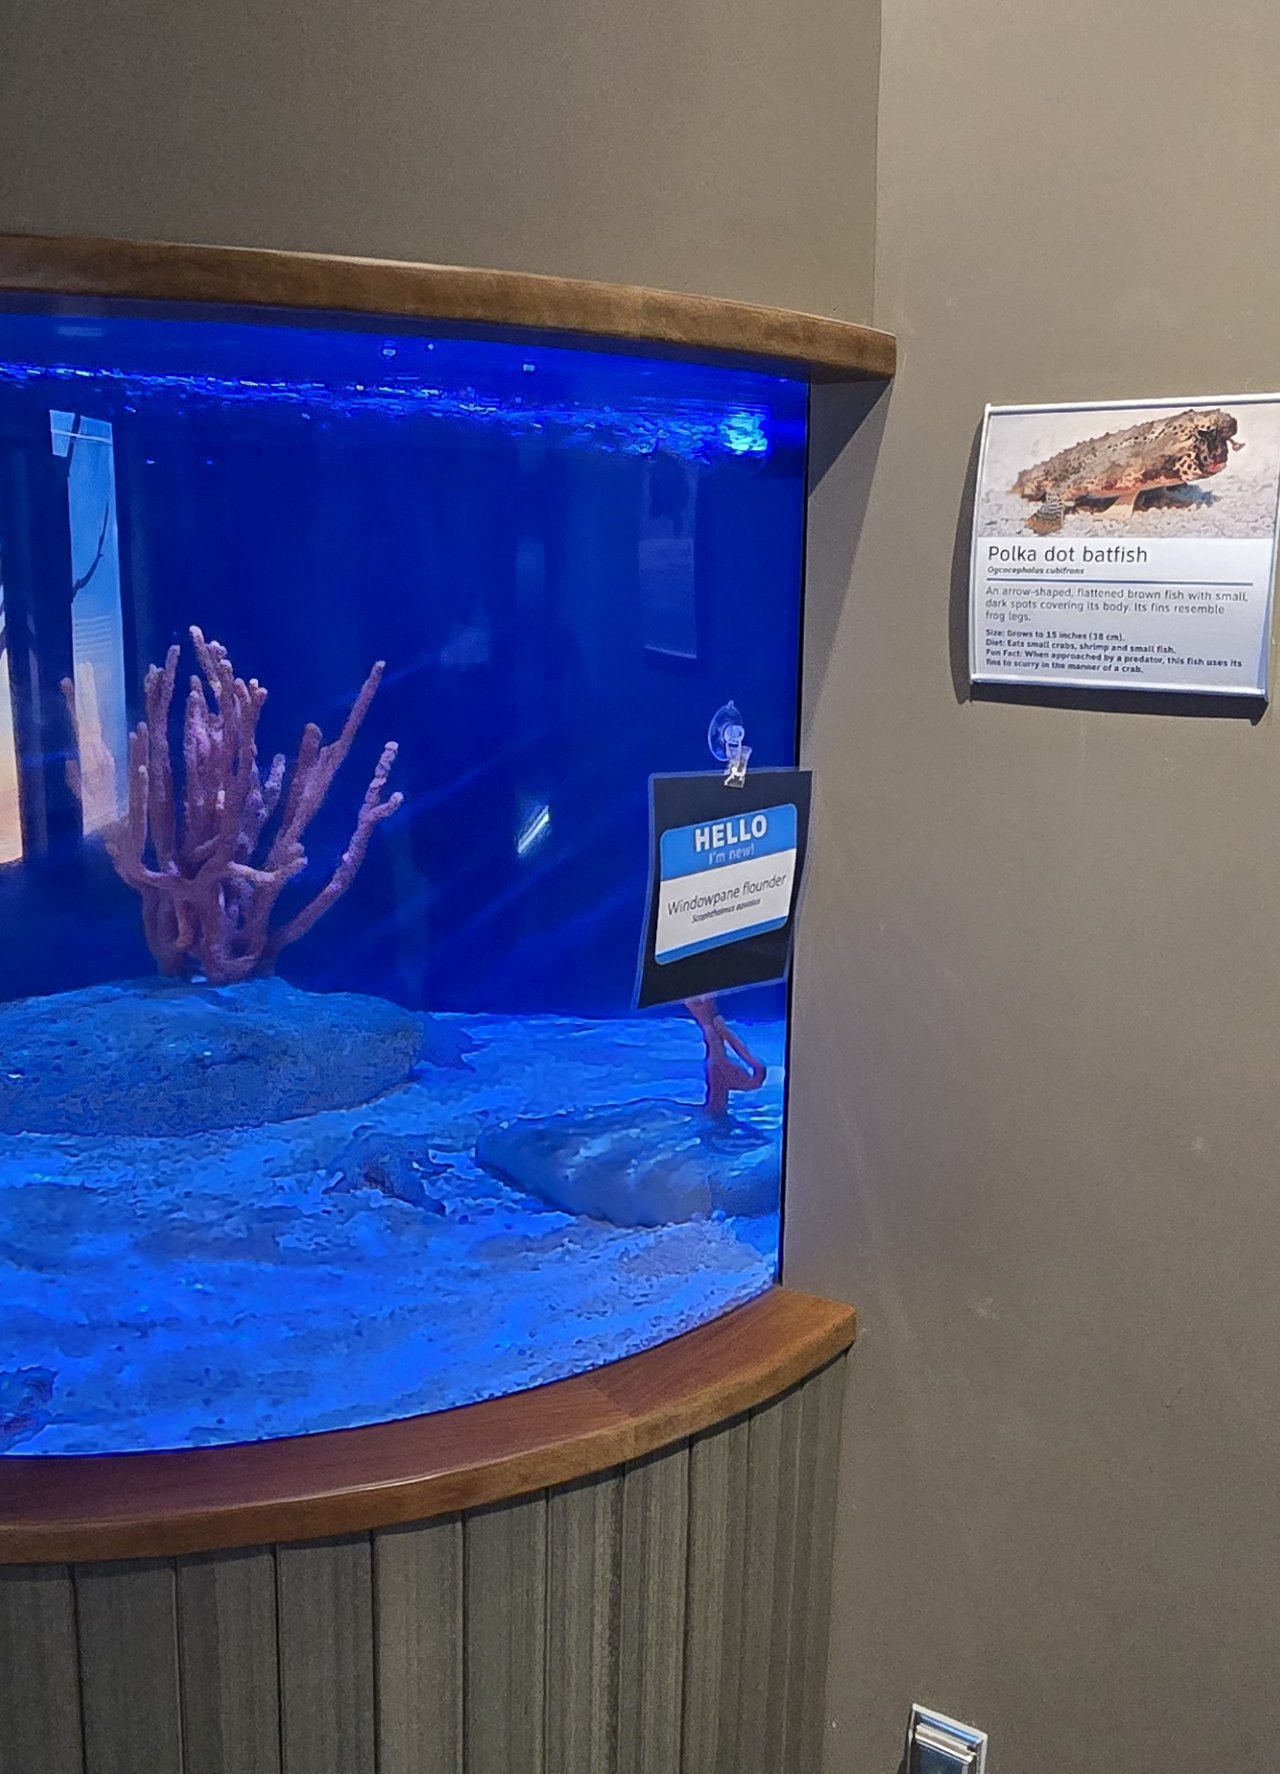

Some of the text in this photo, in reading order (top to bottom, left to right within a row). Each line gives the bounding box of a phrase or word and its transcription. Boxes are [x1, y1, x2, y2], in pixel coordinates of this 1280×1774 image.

[988, 546, 1148, 563] Polka dot batfish
[985, 586, 1249, 602] An arrow-shaped, flattened brown fish with small,
[985, 599, 1225, 614] dark spots covering its body. Its fins resemble
[985, 611, 1031, 623] frog legs.
[985, 629, 1005, 637] Size:
[1007, 630, 1033, 638] Grows
[1035, 630, 1044, 638] to
[1046, 631, 1057, 639] 15
[1059, 631, 1087, 640] inches
[1106, 633, 1125, 642] cm).
[985, 638, 1176, 654] Diet: Eats small crabs, shrimp and small fish.
[985, 658, 1001, 666] fins
[1003, 659, 1012, 667] to
[1014, 661, 1040, 670] scurry
[1052, 661, 1065, 669] the
[1067, 663, 1101, 671] manner
[1121, 665, 1144, 673] crab.
[1025, 650, 1049, 658] When
[1051, 652, 1102, 661] approached
[1104, 654, 1114, 663] by
[1124, 656, 1165, 665] predator,
[1167, 657, 1185, 665] this
[1187, 657, 1205, 666] fish
[1230, 659, 1243, 667] its
[694, 814, 768, 852] HELLO
[708, 843, 755, 865] I'm new!
[667, 874, 787, 915] Windowpane flounder
